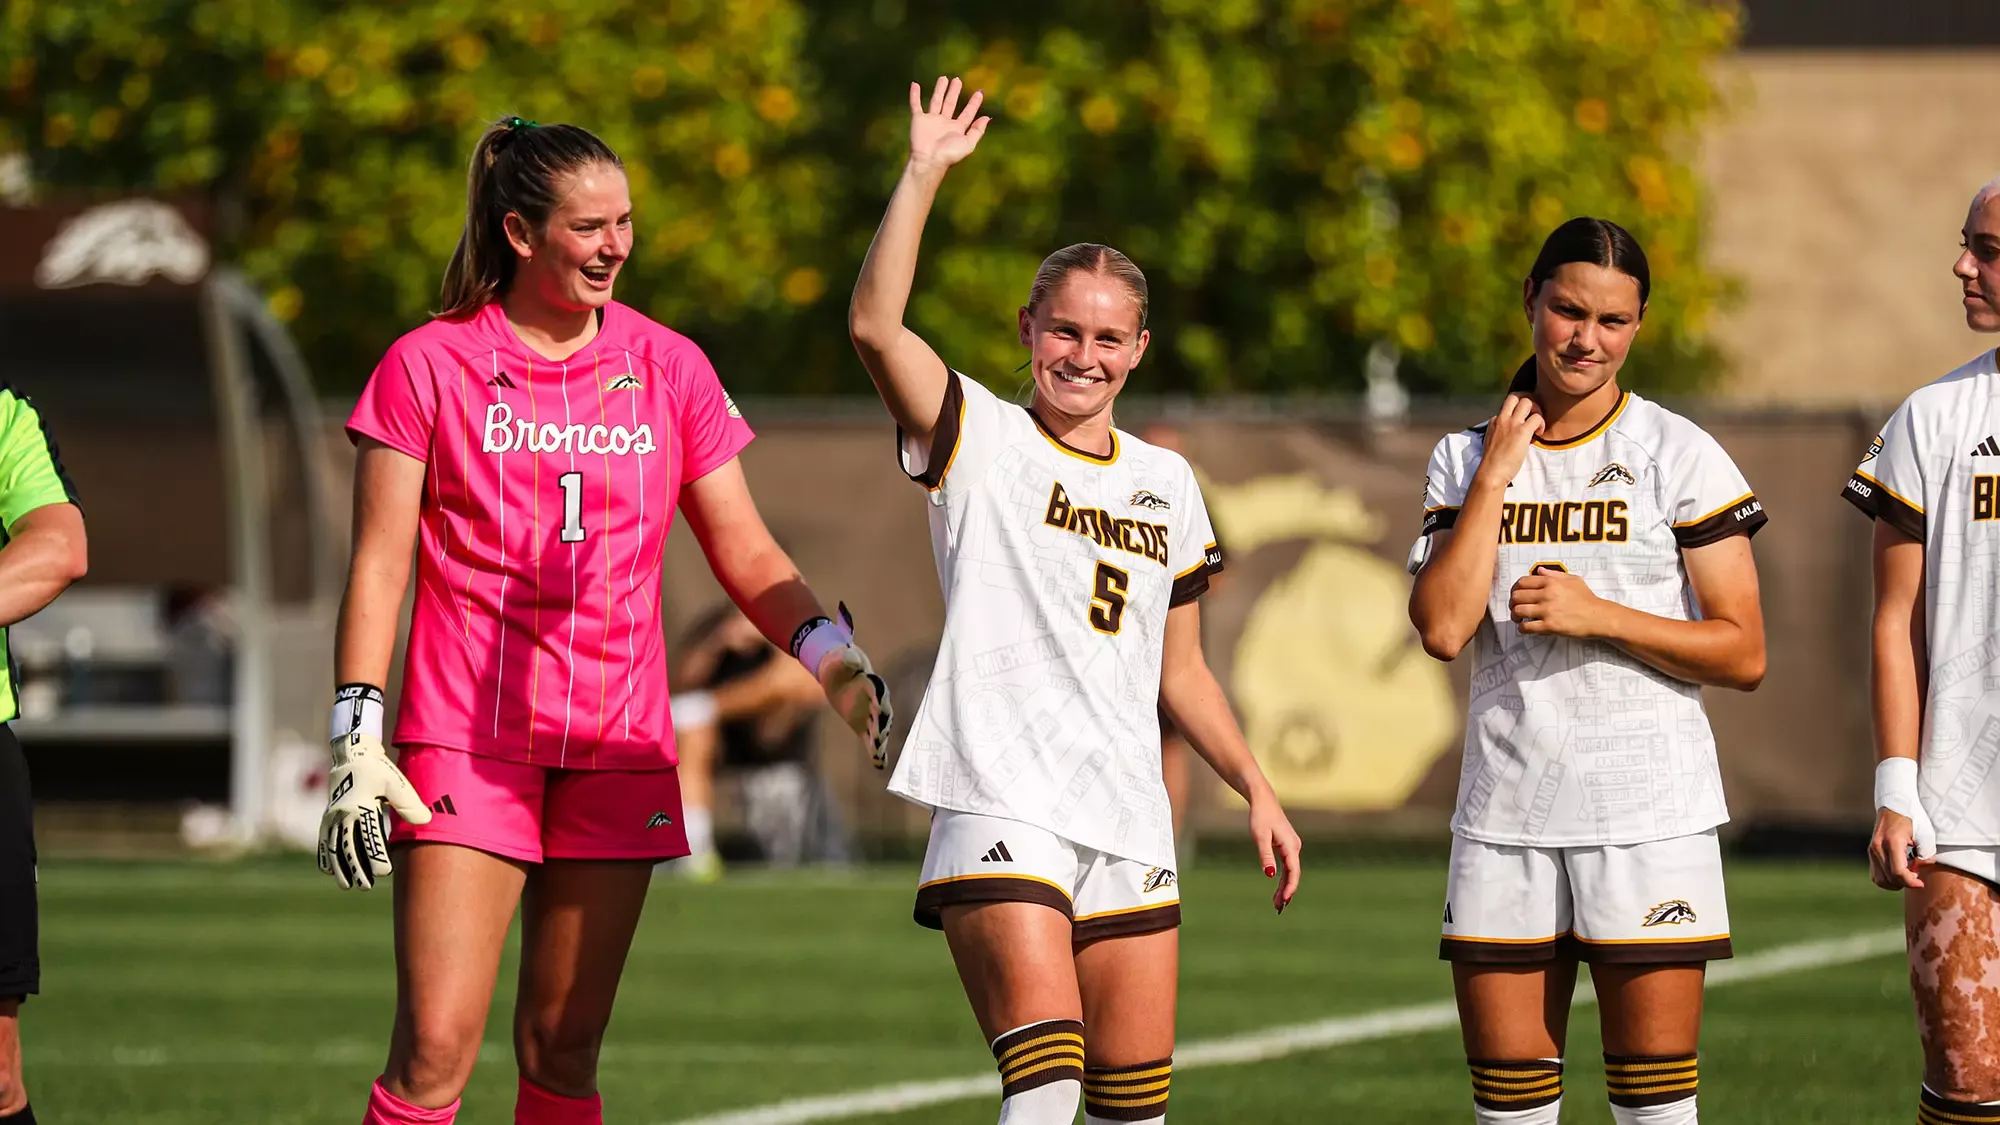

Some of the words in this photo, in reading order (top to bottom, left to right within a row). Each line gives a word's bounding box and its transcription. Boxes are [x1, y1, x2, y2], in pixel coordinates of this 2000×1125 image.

[482, 402, 656, 456] Broncos
[558, 471, 586, 543] 1
[1500, 499, 1630, 545] RONCOS
[1088, 559, 1130, 637] 5
